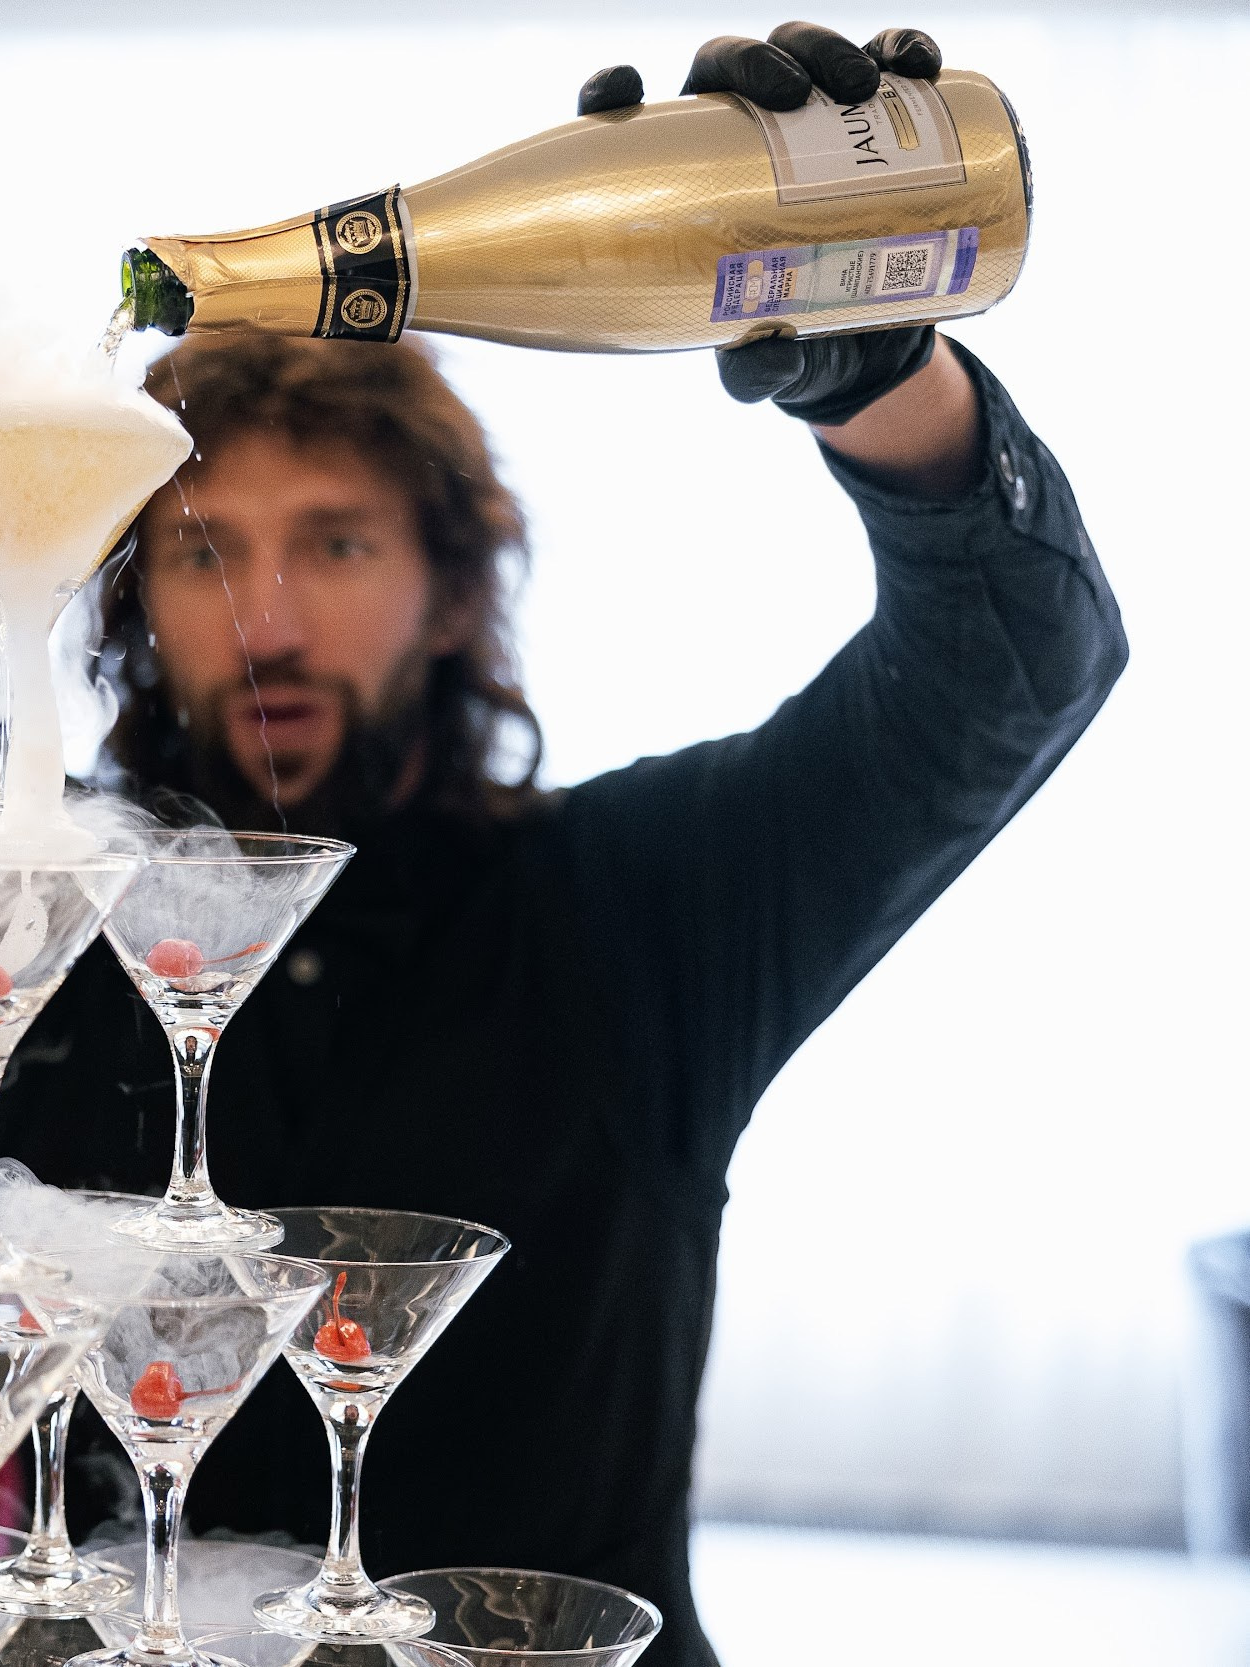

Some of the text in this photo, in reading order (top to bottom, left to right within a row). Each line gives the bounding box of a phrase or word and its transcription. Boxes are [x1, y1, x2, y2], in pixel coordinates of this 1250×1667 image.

[723, 263, 736, 316] РОССИЙСКАЯ
[731, 262, 743, 314] ФЕДЕРАЦИЯ
[764, 257, 779, 312] ФЕДЕРАЛЬНАЯ
[772, 256, 786, 311] СПЕЦИАЛЬНАЯ
[783, 271, 793, 298] МАРКА
[840, 269, 848, 286] ВИНА
[845, 260, 856, 293] ИГРИСТЫЕ
[851, 250, 864, 298] (ШАМПАНСКИЕ)
